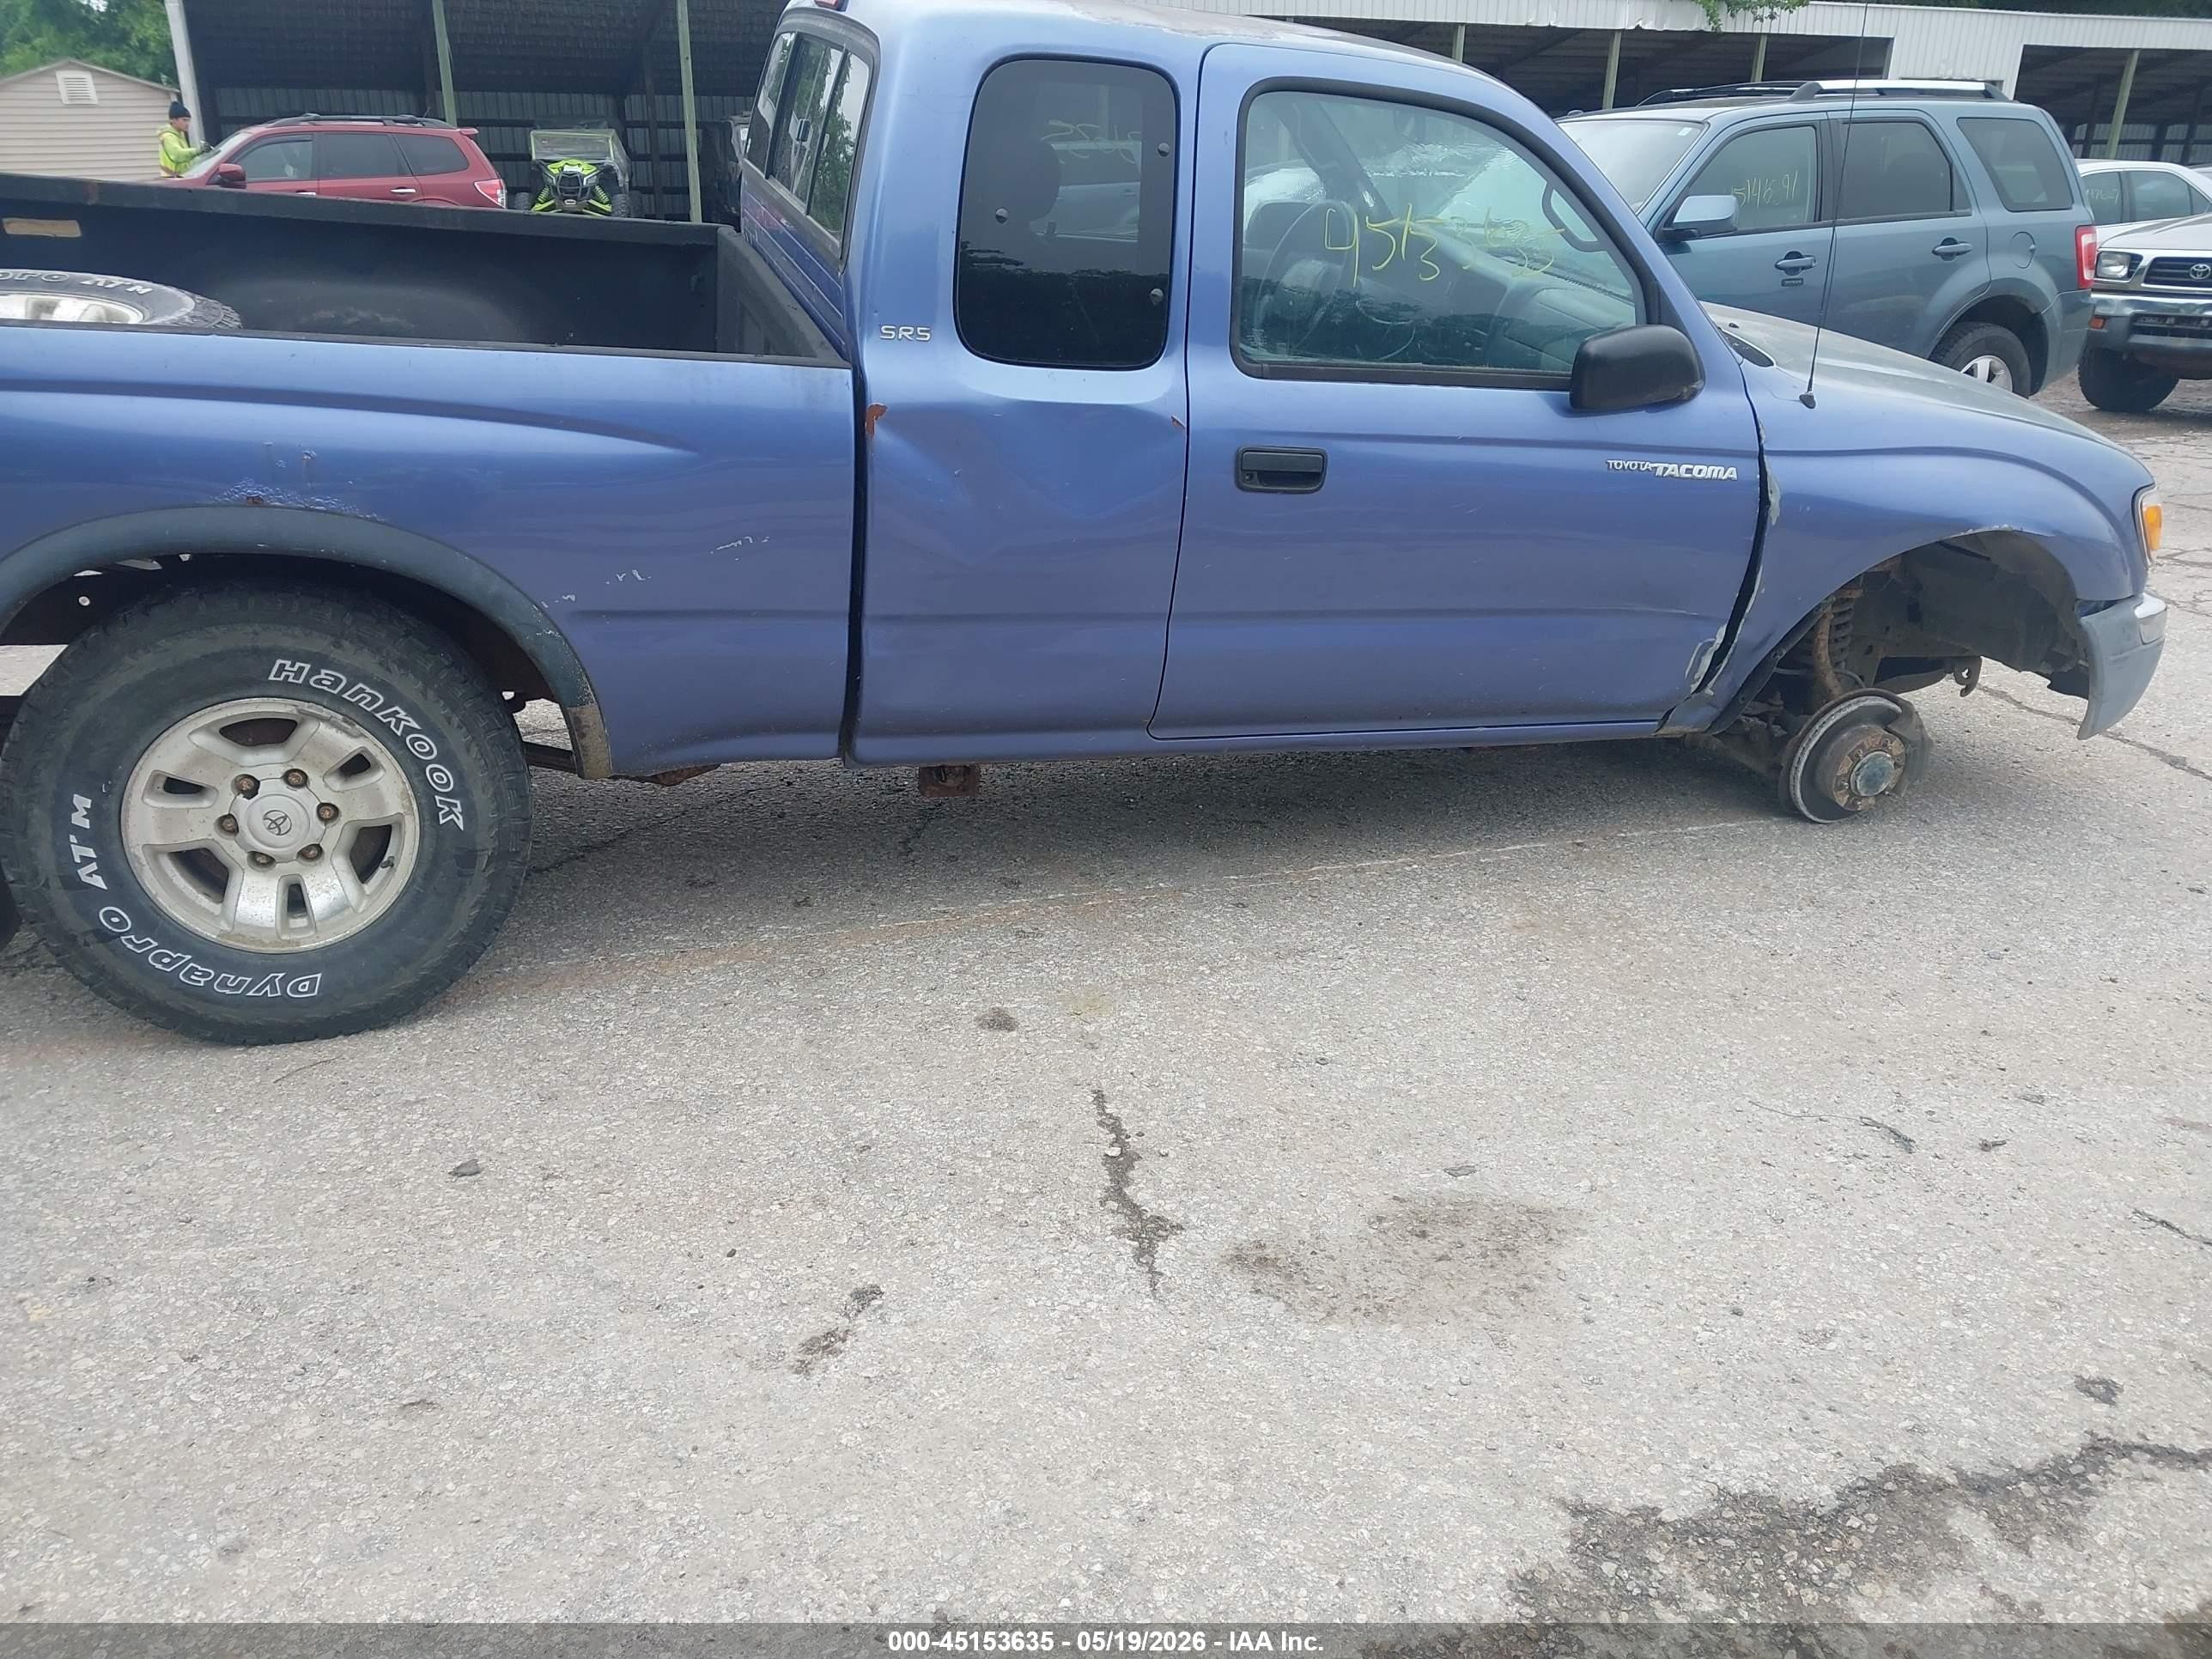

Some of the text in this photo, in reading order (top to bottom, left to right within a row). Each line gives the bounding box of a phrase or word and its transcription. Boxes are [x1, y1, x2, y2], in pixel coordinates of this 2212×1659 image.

[879, 325, 932, 342] SR5
[1607, 459, 1738, 481] TOYOTA TACOMA
